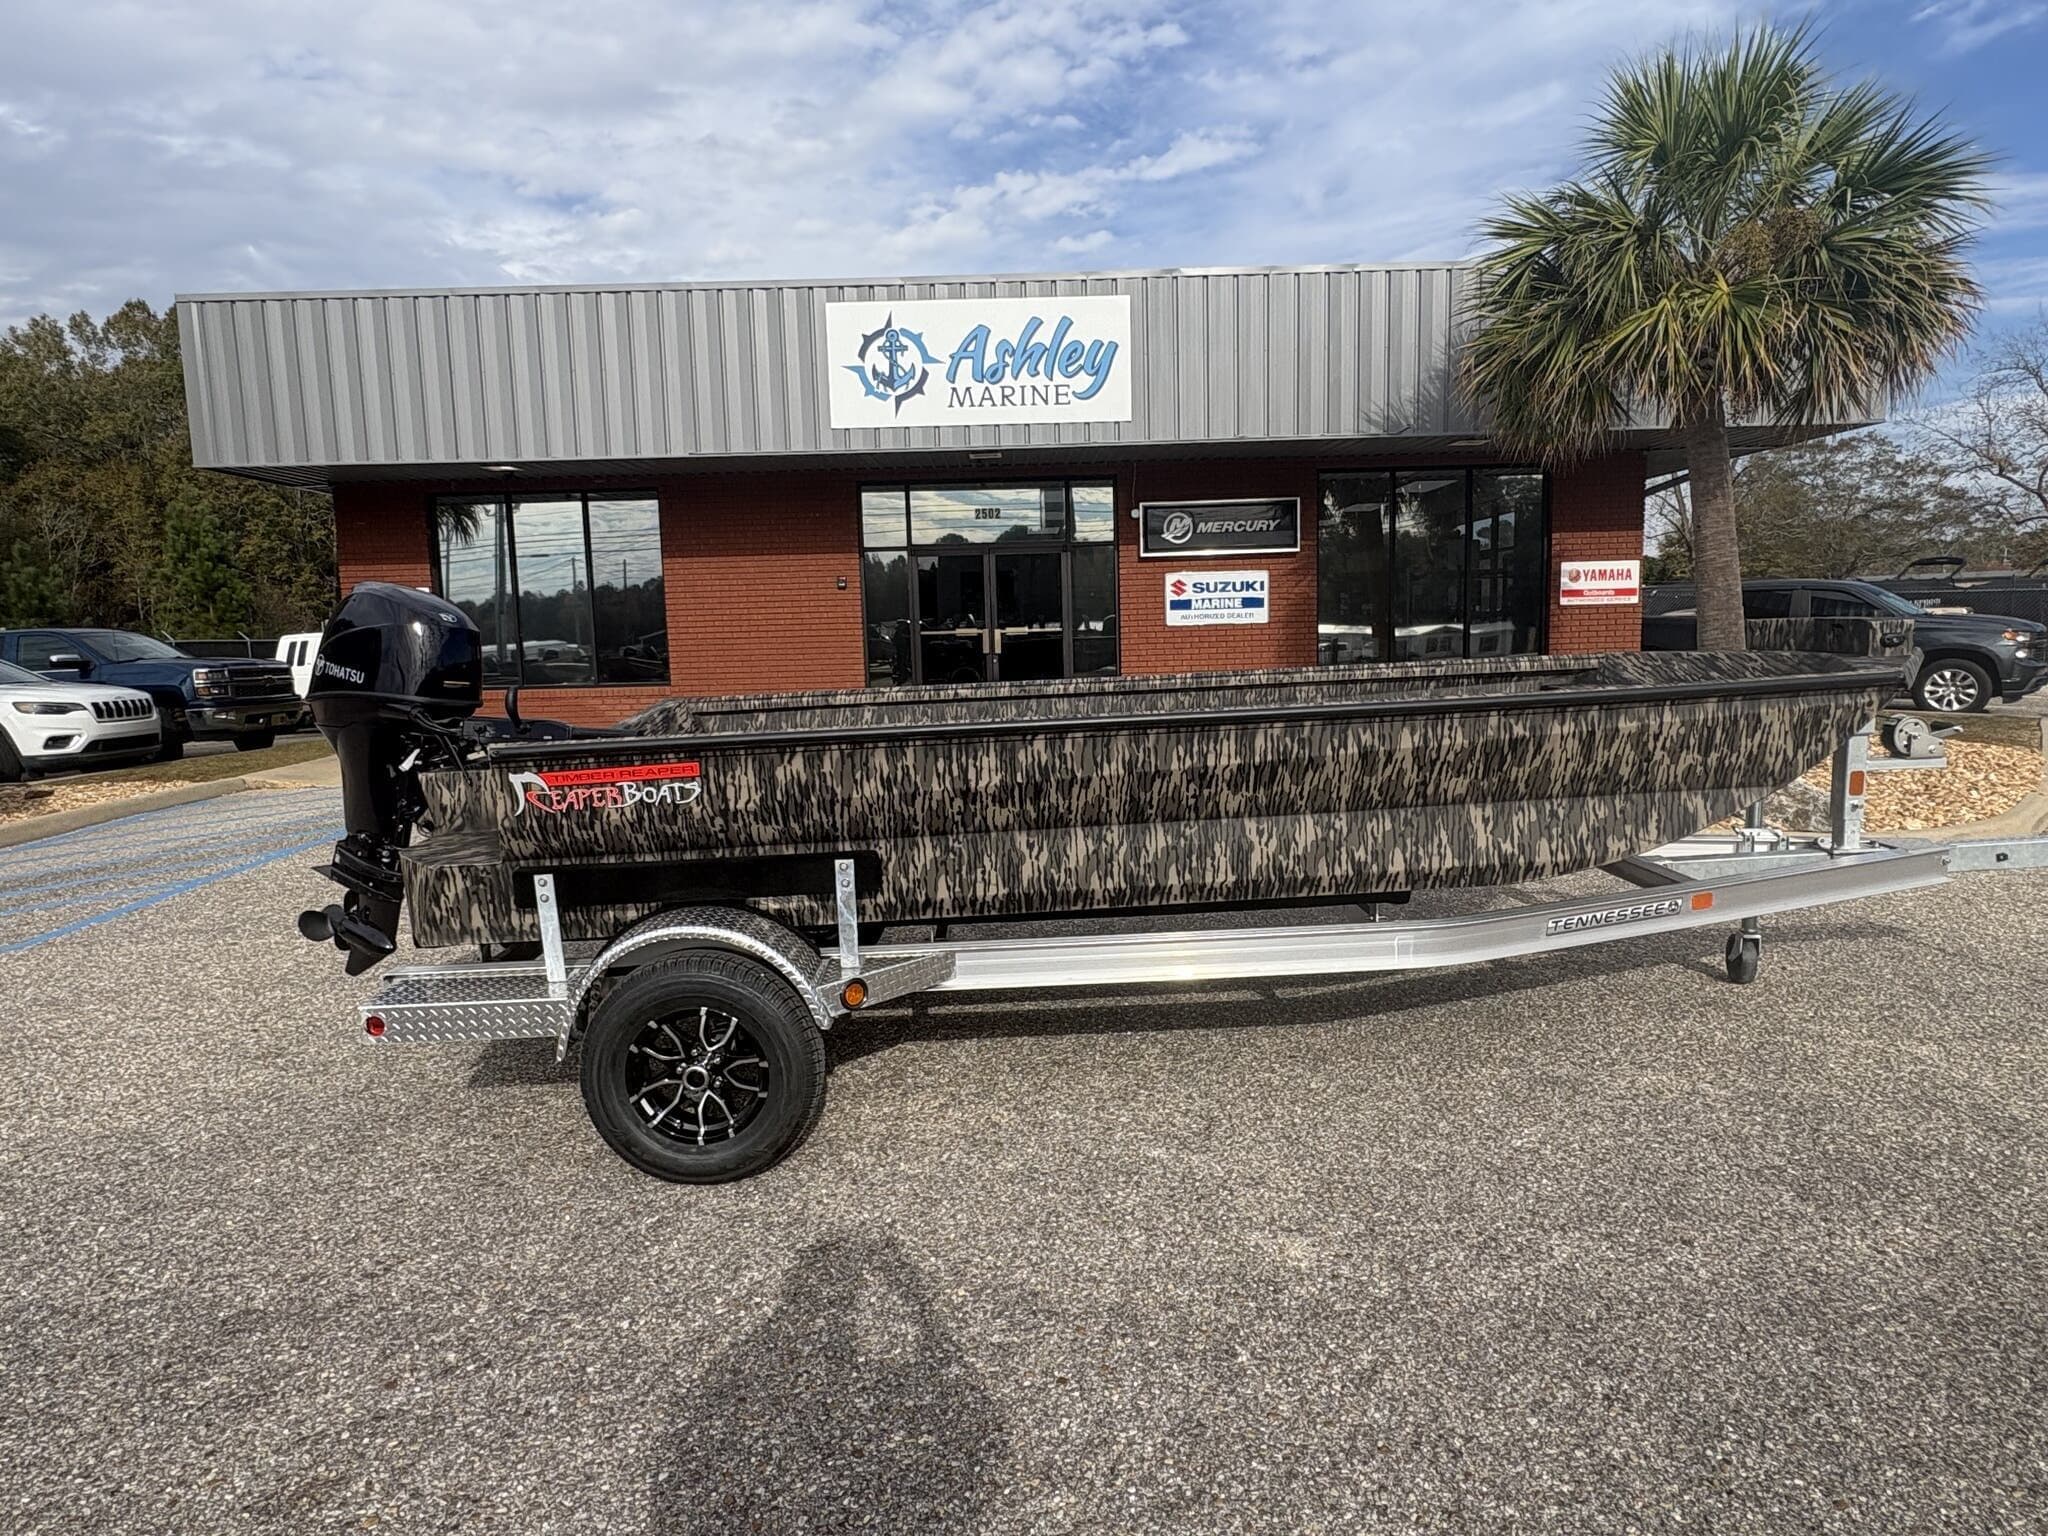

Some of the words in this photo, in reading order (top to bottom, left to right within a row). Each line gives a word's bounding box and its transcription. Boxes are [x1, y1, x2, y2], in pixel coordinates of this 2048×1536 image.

[945, 315, 1120, 401] Ashley
[947, 384, 1073, 409] MARINE
[974, 507, 1002, 520] 2502
[1196, 518, 1281, 534] MERCURY
[1582, 567, 1633, 582] YAMAHA
[1192, 580, 1265, 594] SUZUKI
[1190, 597, 1243, 610] MARINE
[324, 661, 365, 685] TOHATSU
[551, 772, 616, 784] TIMBER
[618, 764, 695, 779] REAPER
[1551, 902, 1666, 932] TENNESSEE
